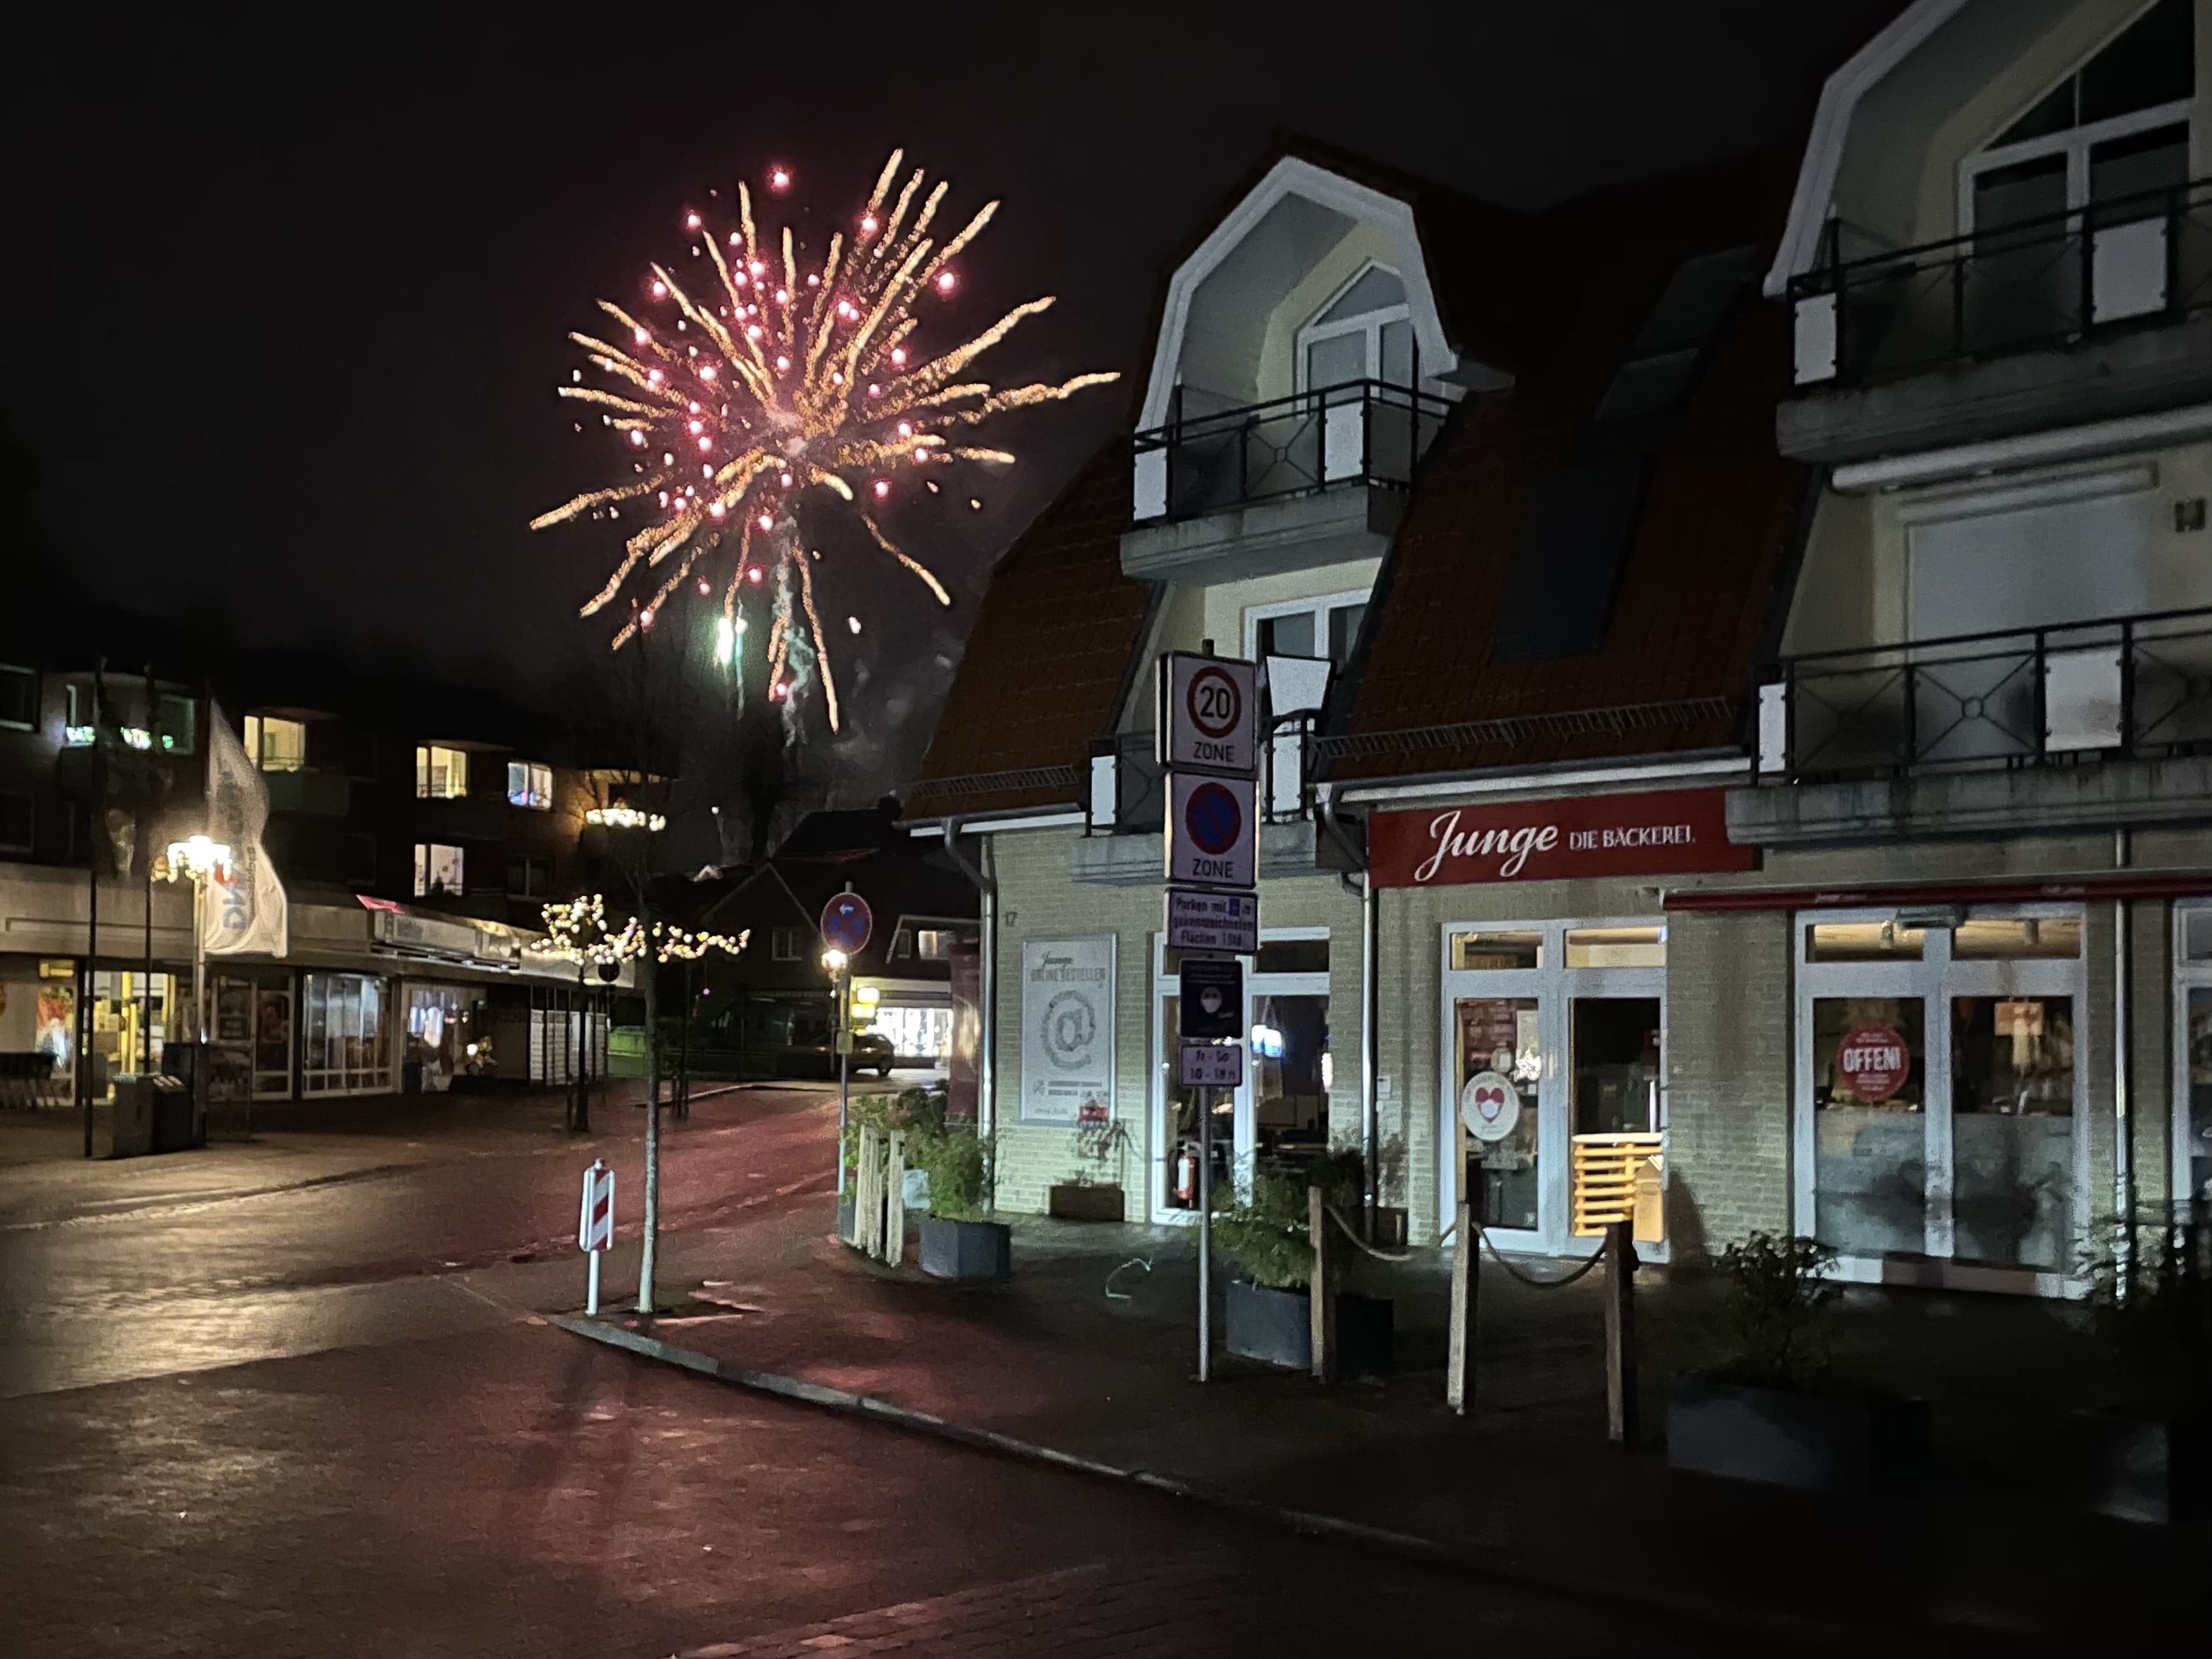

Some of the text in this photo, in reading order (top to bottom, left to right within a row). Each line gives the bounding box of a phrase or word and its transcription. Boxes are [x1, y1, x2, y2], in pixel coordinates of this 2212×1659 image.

[1200, 687, 1230, 719] 20
[1193, 742, 1235, 762] ZONE
[1414, 810, 1558, 882] Junge
[1570, 830, 1598, 851] DIE
[1193, 858, 1234, 879] ZONE
[1175, 897, 1208, 912] Parken
